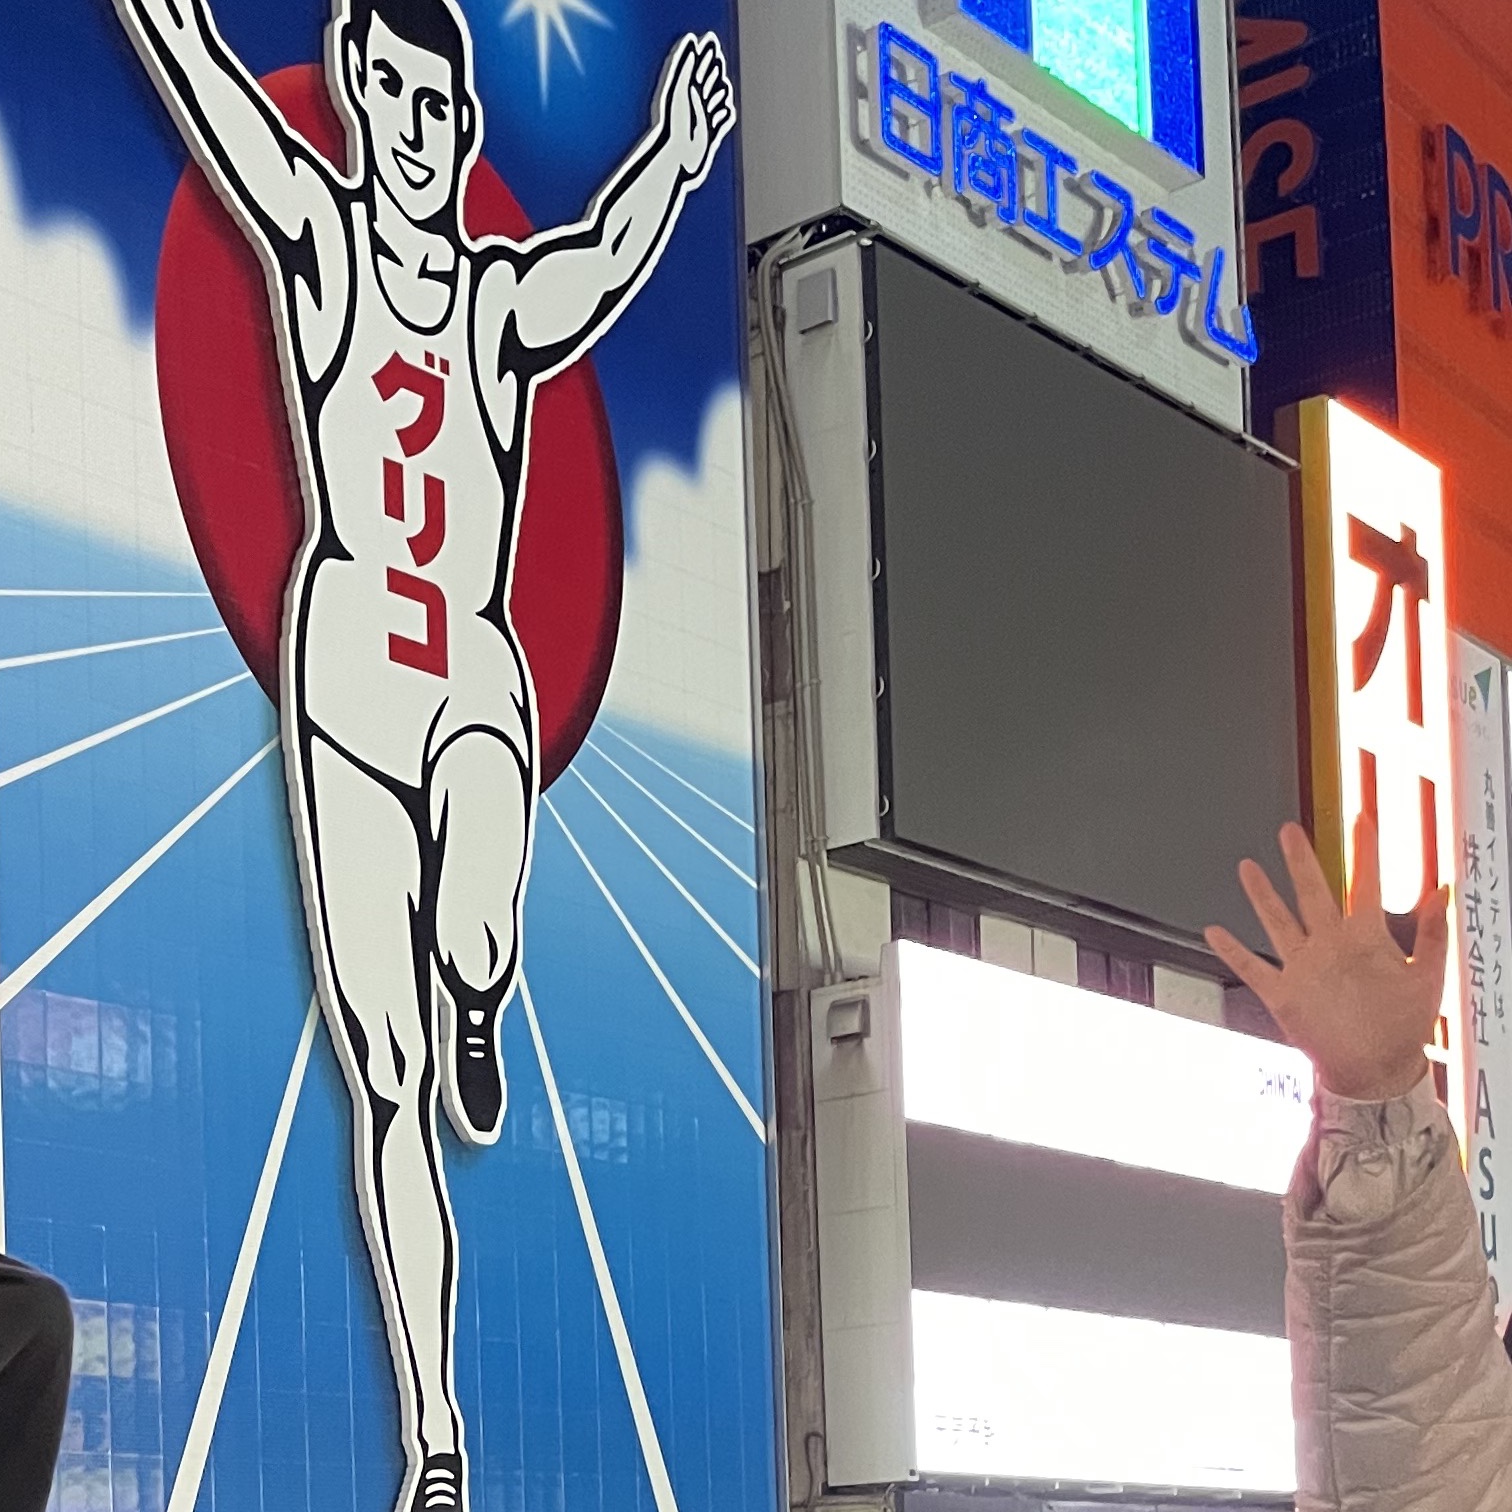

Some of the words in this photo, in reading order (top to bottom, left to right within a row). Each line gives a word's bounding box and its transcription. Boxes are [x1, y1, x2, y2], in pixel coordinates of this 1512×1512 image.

[878, 20, 1258, 366] 日商エステム
[371, 350, 450, 680] グリコ
[1463, 830, 1490, 1047] 株式会社
